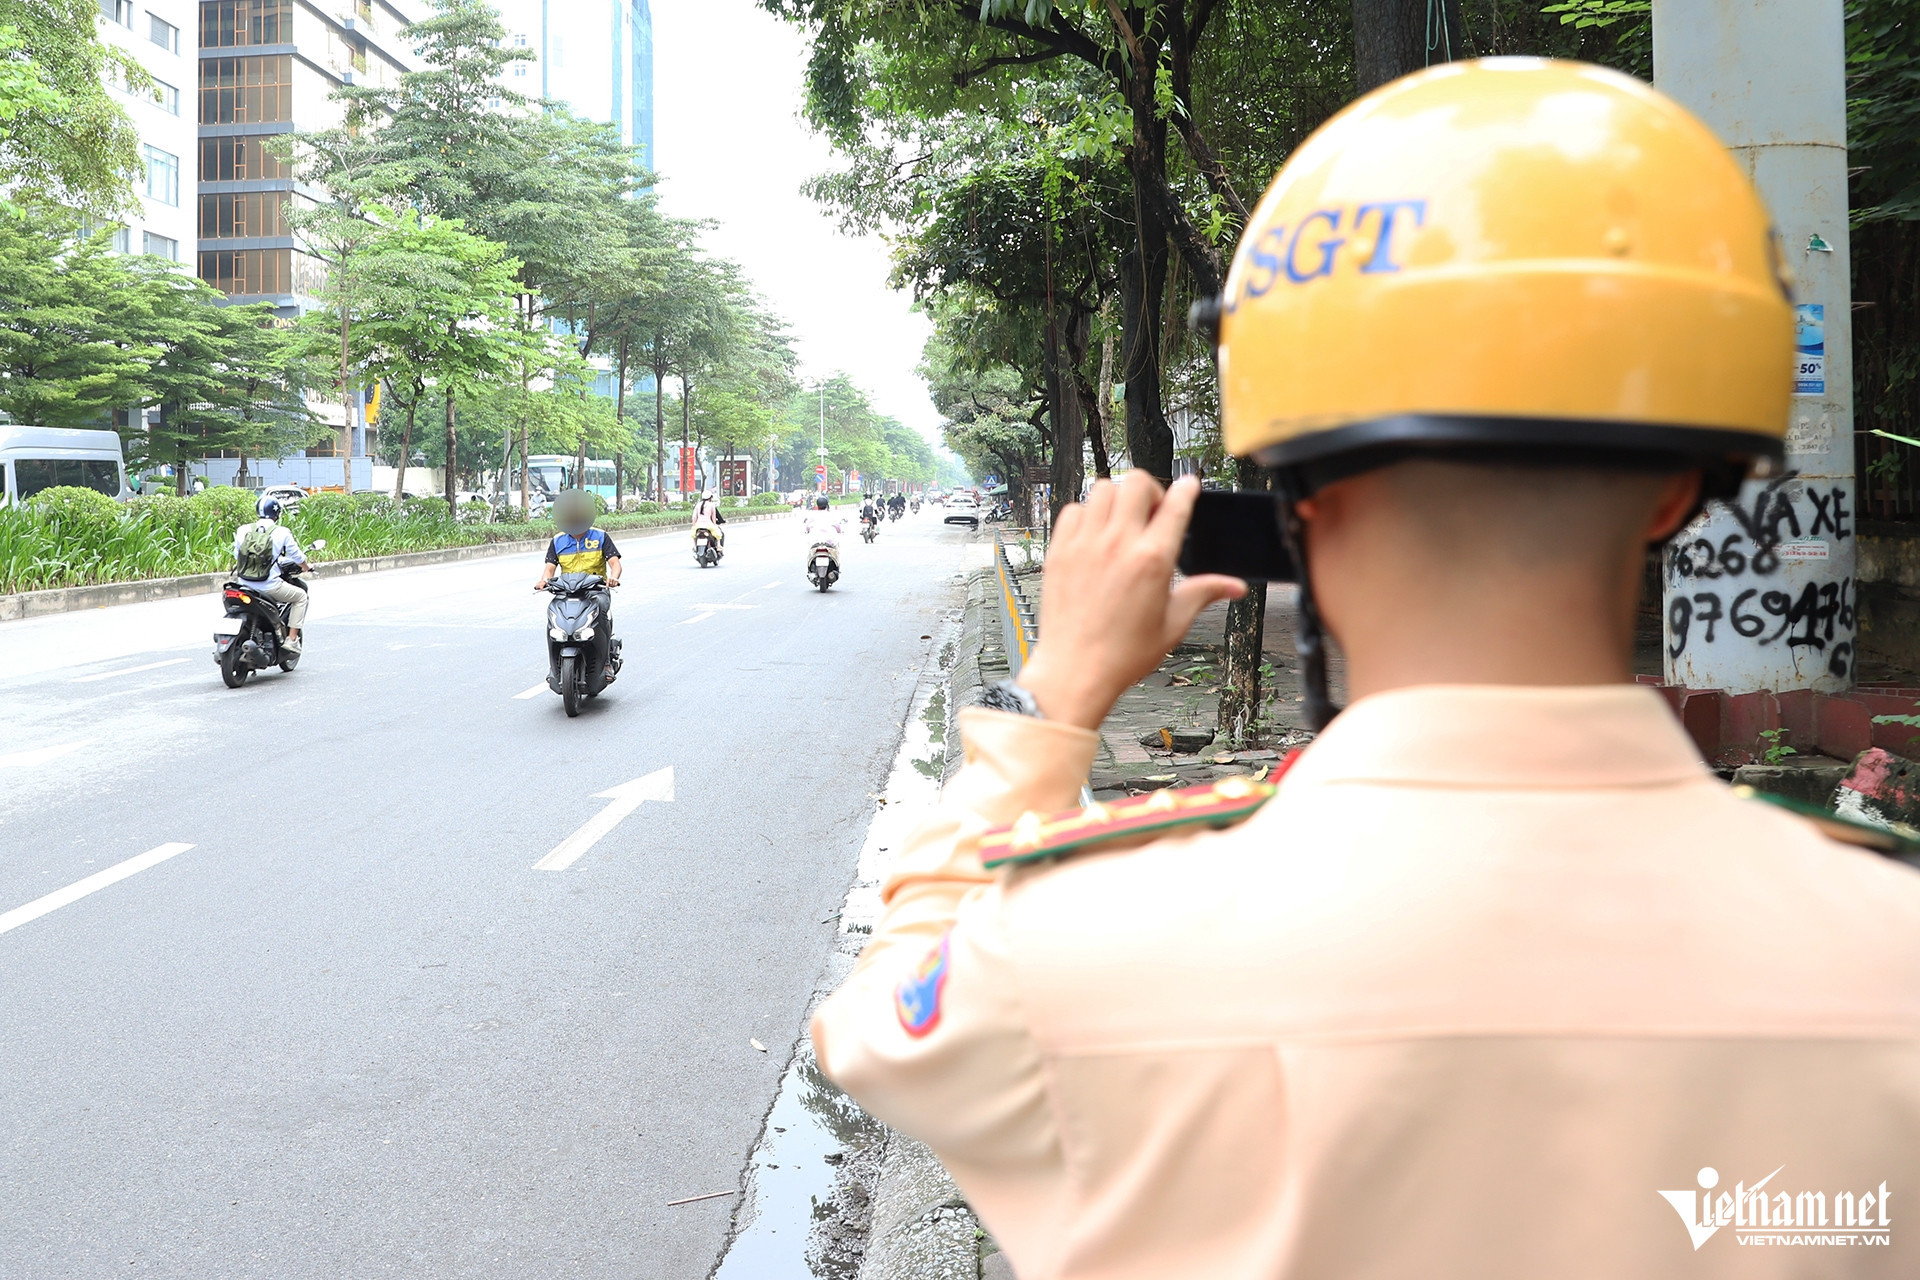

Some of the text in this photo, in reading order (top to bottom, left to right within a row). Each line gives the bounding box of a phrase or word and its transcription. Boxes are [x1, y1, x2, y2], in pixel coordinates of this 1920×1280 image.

[1224, 200, 1427, 314] SGT
[1807, 487, 1851, 540] XE
[584, 537, 600, 549] be
